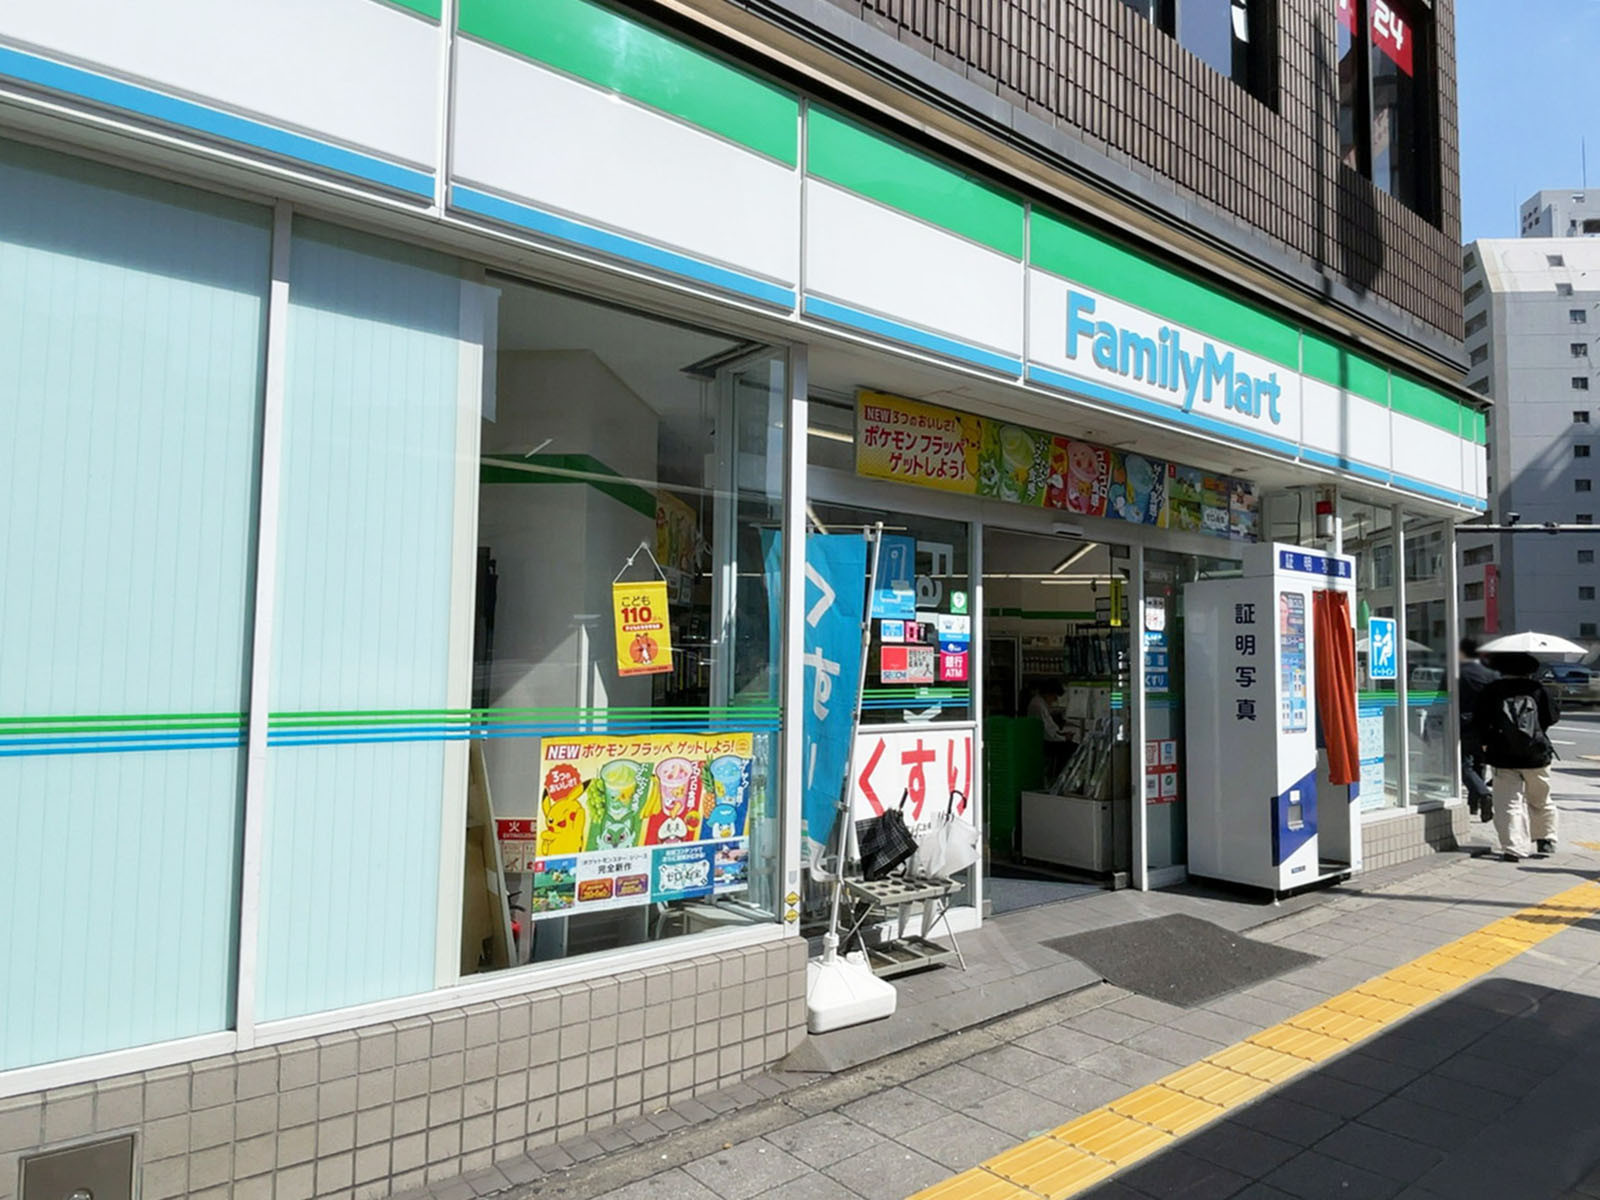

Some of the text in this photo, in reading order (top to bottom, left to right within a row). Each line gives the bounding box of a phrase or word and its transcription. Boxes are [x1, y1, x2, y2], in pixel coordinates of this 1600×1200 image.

[1374, 0, 1403, 50] 24
[1065, 289, 1281, 425] FamilyMart
[866, 405, 890, 422] NEW
[864, 425, 917, 450] ポケモン
[889, 452, 965, 480] ゲットしよう!
[621, 595, 651, 607] こども
[621, 606, 652, 623] 110
[945, 668, 963, 678] ATM
[1235, 603, 1256, 720] 証明写真
[547, 744, 580, 759] NEW
[582, 743, 628, 758] ポケモン
[677, 740, 735, 754] ゲットしよう!
[859, 737, 971, 821] くすり
